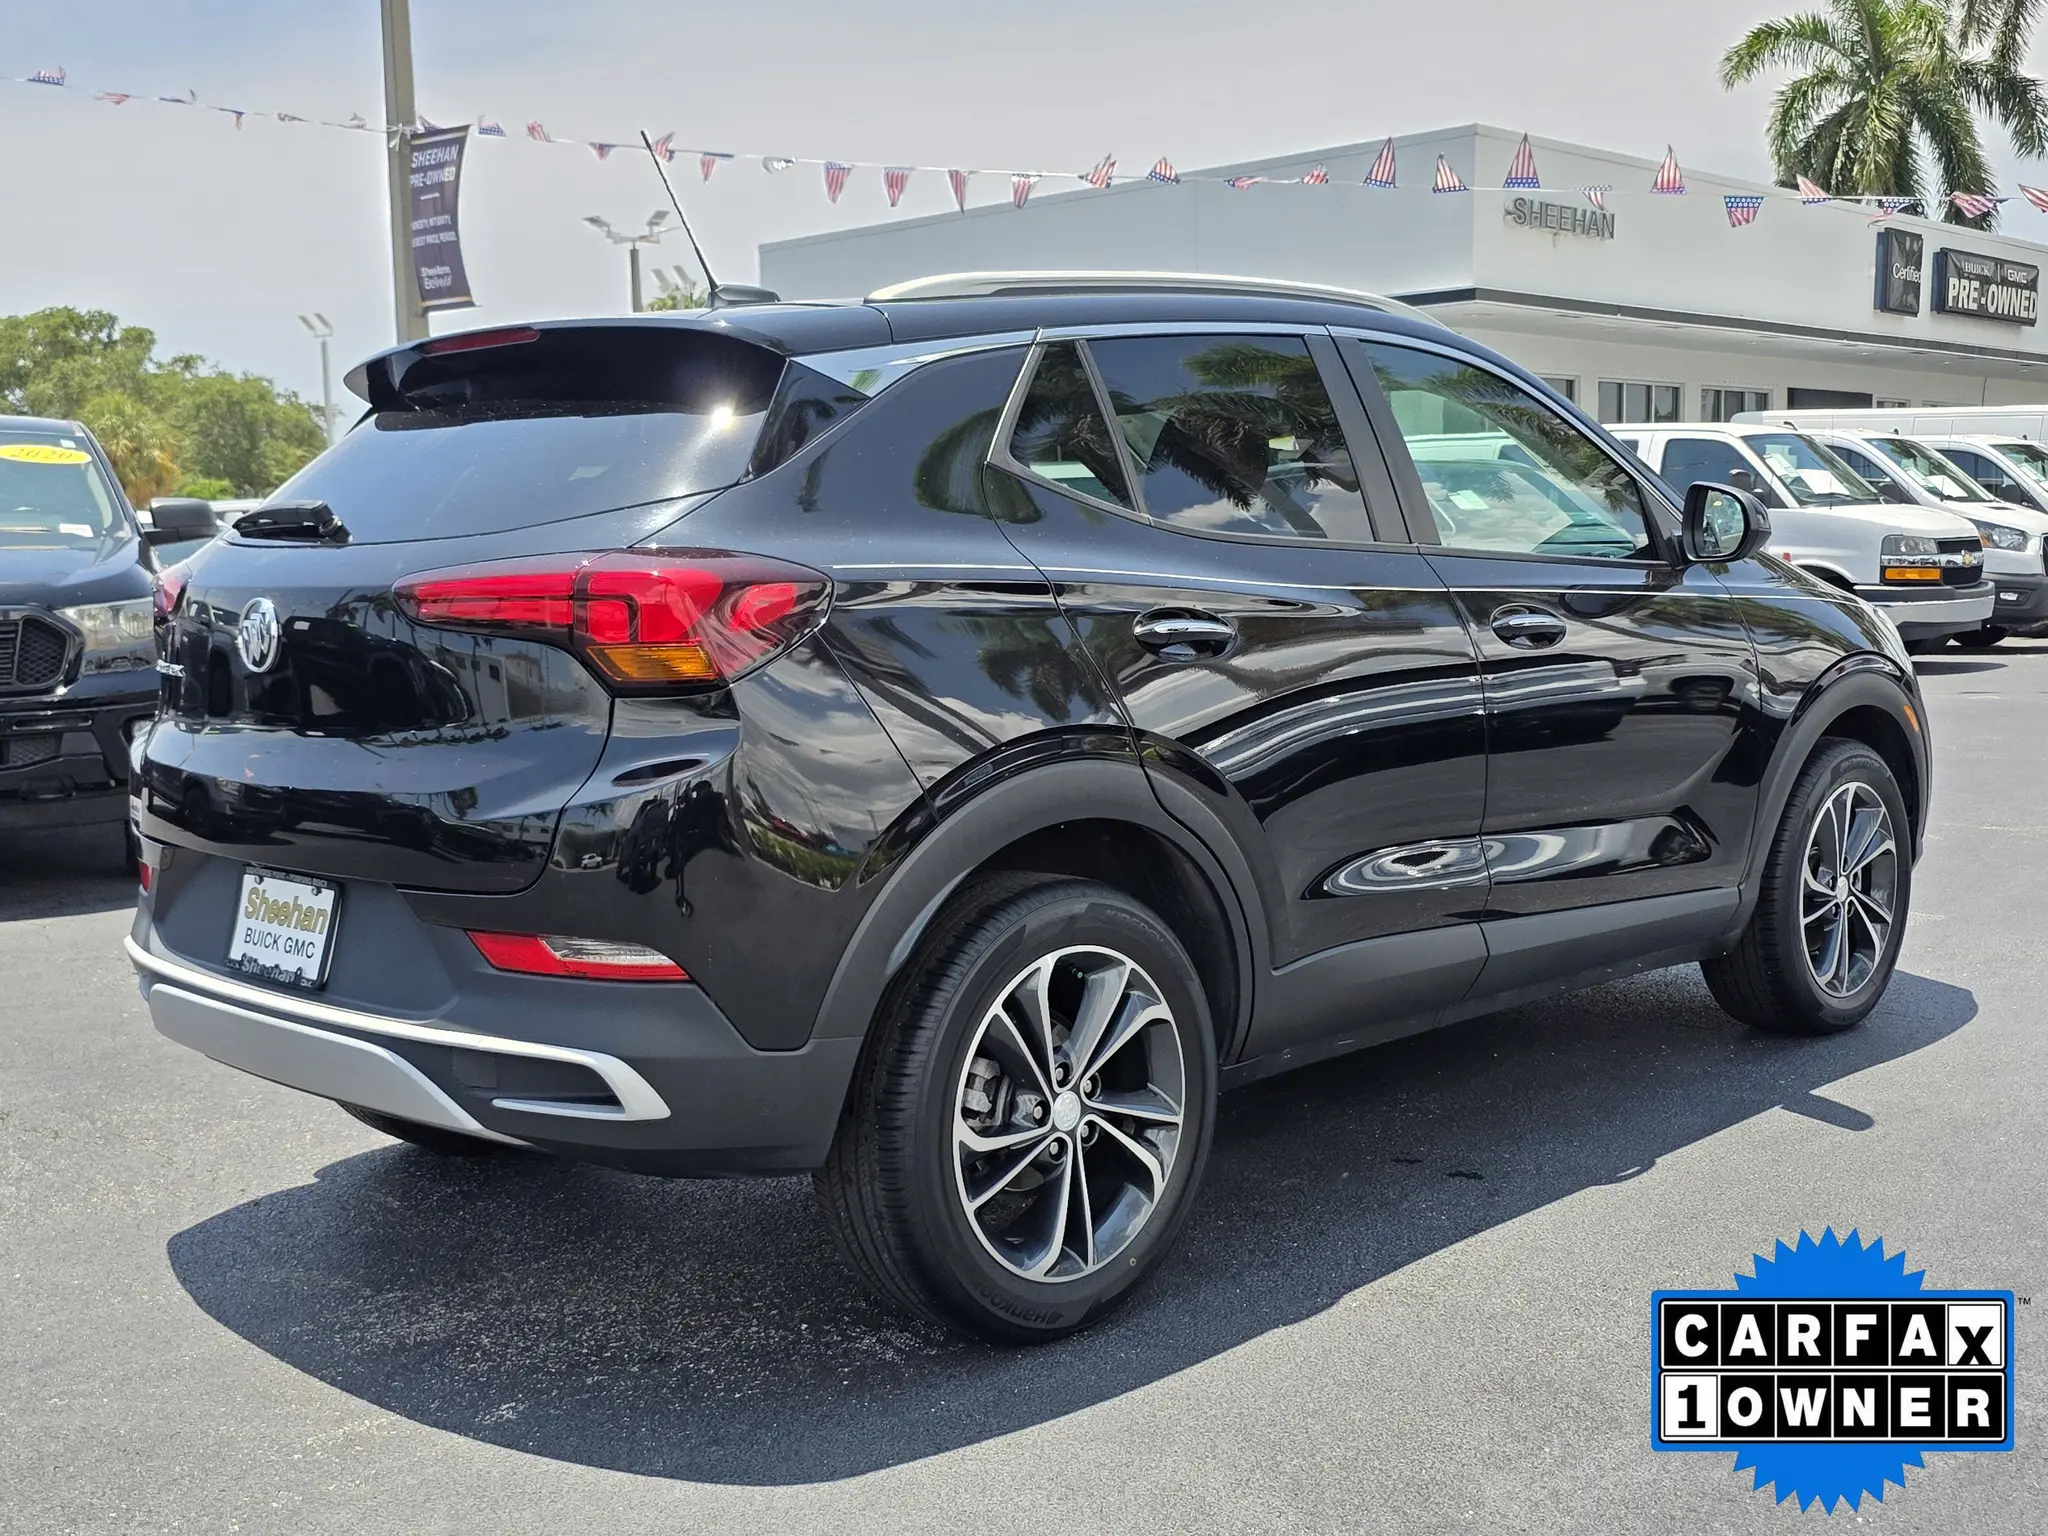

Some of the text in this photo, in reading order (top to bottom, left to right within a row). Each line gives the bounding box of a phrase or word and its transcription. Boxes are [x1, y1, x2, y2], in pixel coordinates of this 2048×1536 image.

[411, 144, 459, 168] SHEEHAN
[410, 166, 456, 188] PRE-OWNED
[1512, 197, 1615, 240] SHEEHAN
[1965, 261, 2028, 284] BUICK GMC
[1948, 277, 2038, 320] PRE-OWNED
[10, 447, 73, 460] 2020
[244, 886, 329, 935] Sheehan
[244, 927, 316, 959] BUICK GMC
